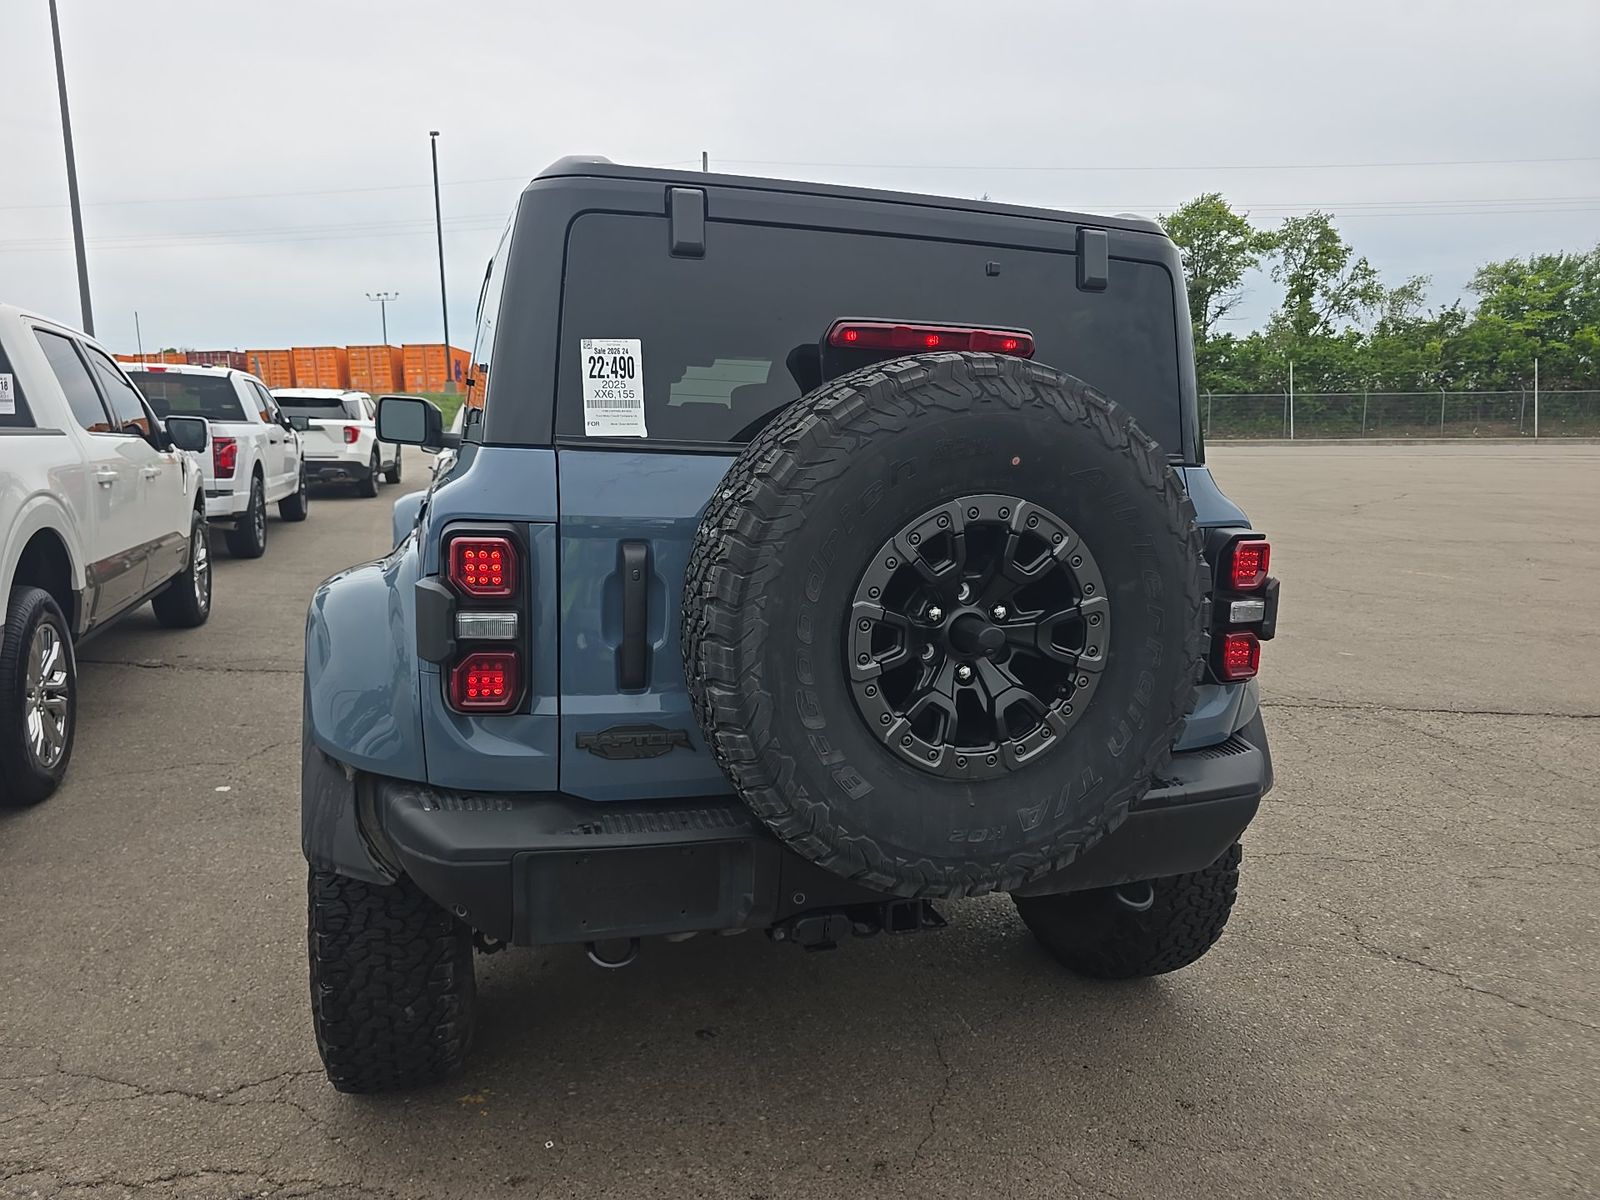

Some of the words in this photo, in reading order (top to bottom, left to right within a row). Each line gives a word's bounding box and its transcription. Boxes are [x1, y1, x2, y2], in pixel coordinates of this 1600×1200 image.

[593, 347, 606, 355] Sale
[588, 355, 635, 379] 22:490
[602, 380, 627, 389] 2025
[594, 389, 635, 399] XX6,155
